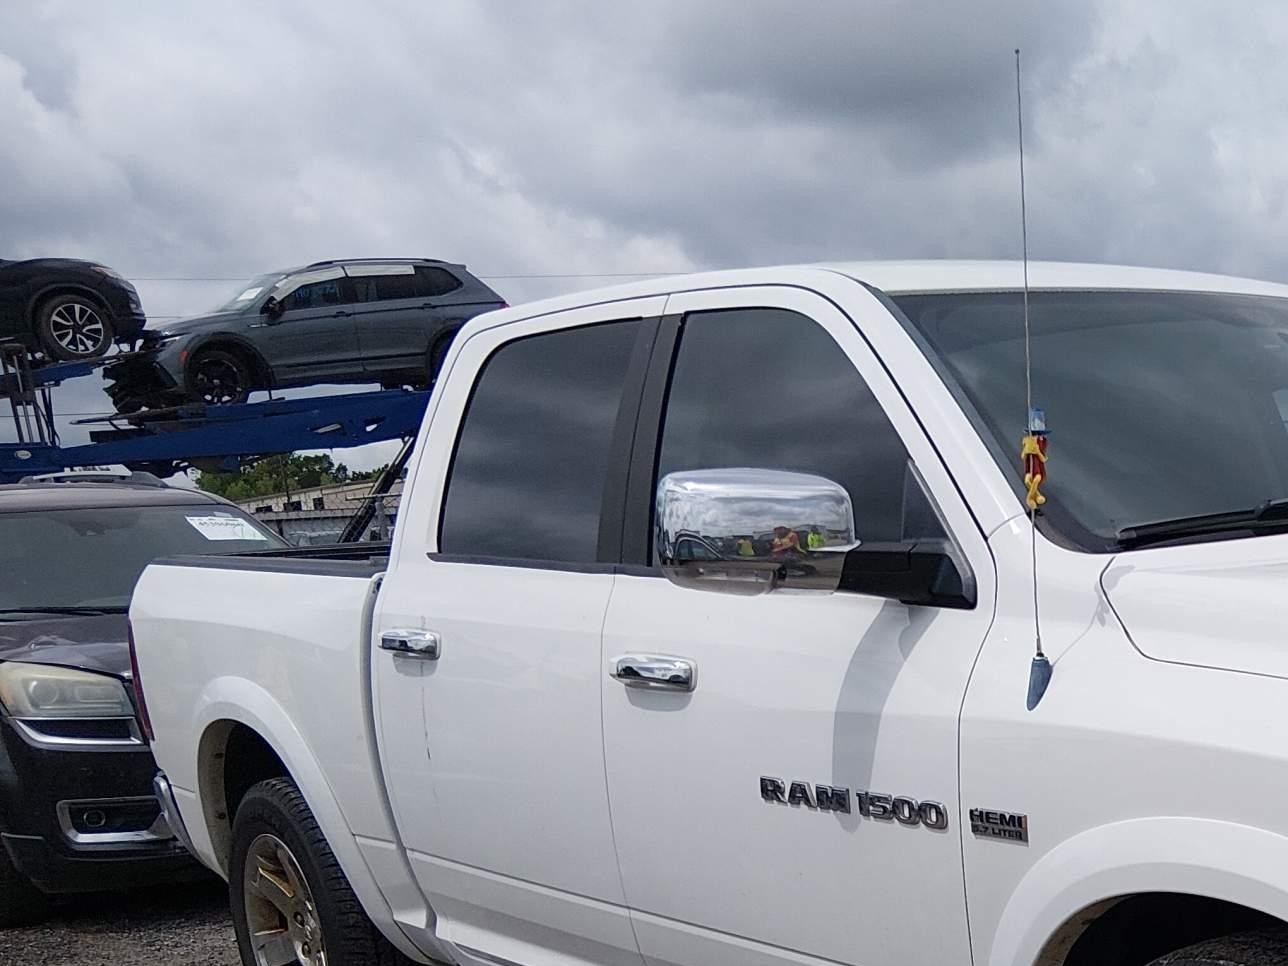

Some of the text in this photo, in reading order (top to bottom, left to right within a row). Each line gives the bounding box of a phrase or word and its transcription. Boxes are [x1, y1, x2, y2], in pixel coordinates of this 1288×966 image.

[760, 776, 949, 830] RAM 1500
[969, 808, 1023, 829] HEMI
[992, 827, 1023, 841] LITER
